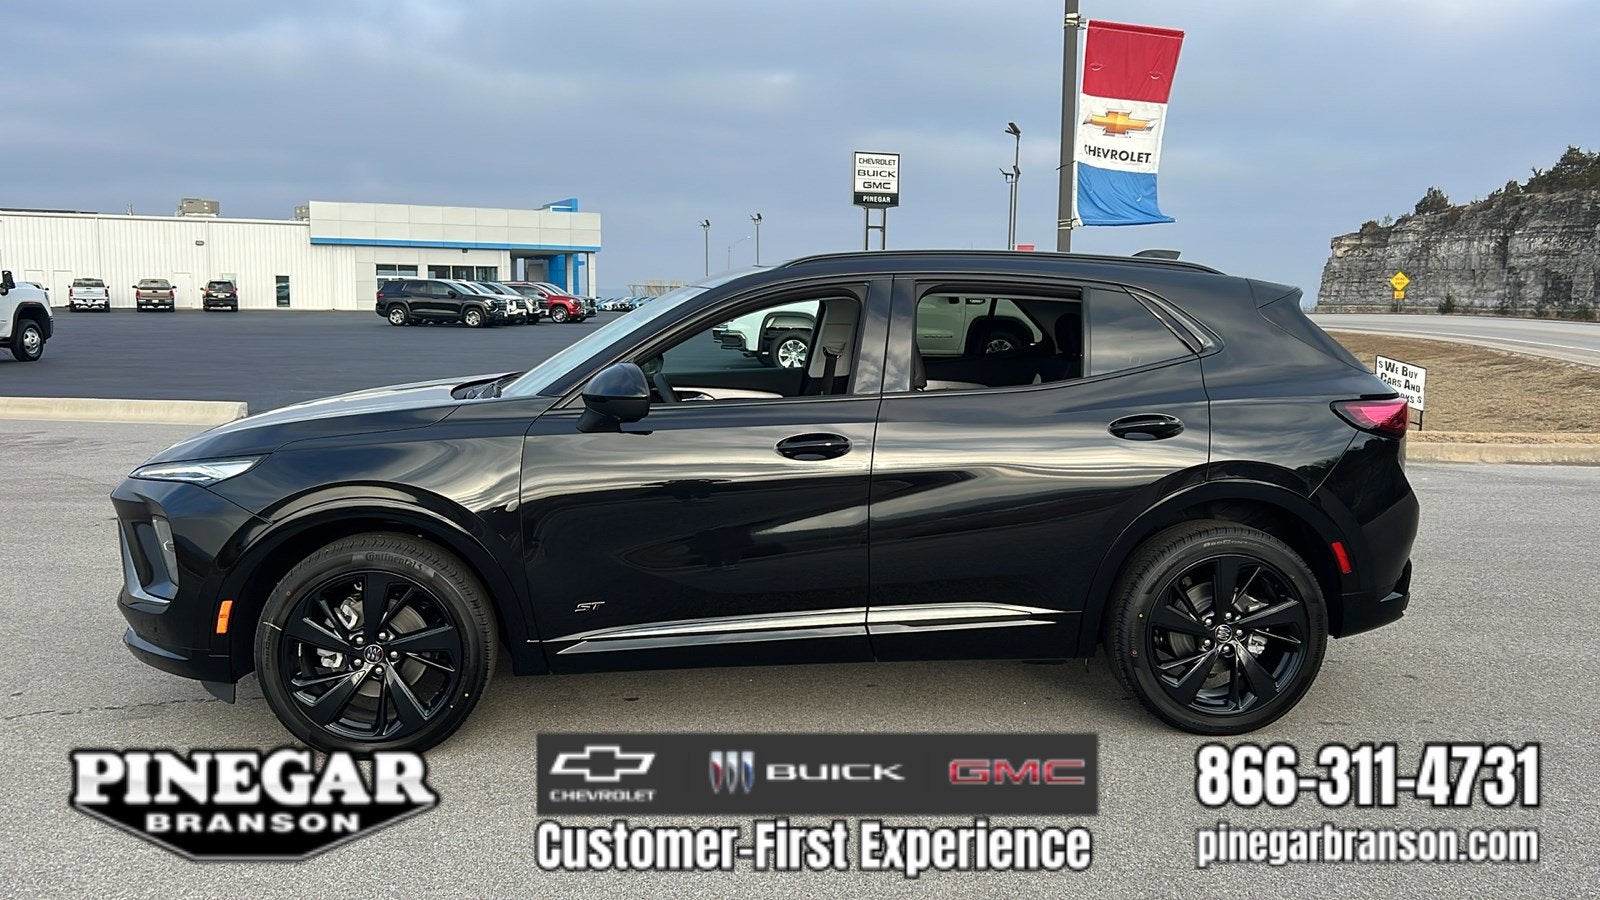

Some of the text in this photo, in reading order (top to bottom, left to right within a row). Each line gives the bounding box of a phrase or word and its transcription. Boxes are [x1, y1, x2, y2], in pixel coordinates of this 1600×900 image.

[858, 157, 896, 166] CHEVROLET
[857, 169, 896, 178] BUICK
[862, 181, 891, 190] GMC
[862, 195, 891, 203] PINEGAR
[1401, 365, 1418, 380] BUY
[1403, 379, 1421, 393] AND
[574, 601, 606, 613] ST
